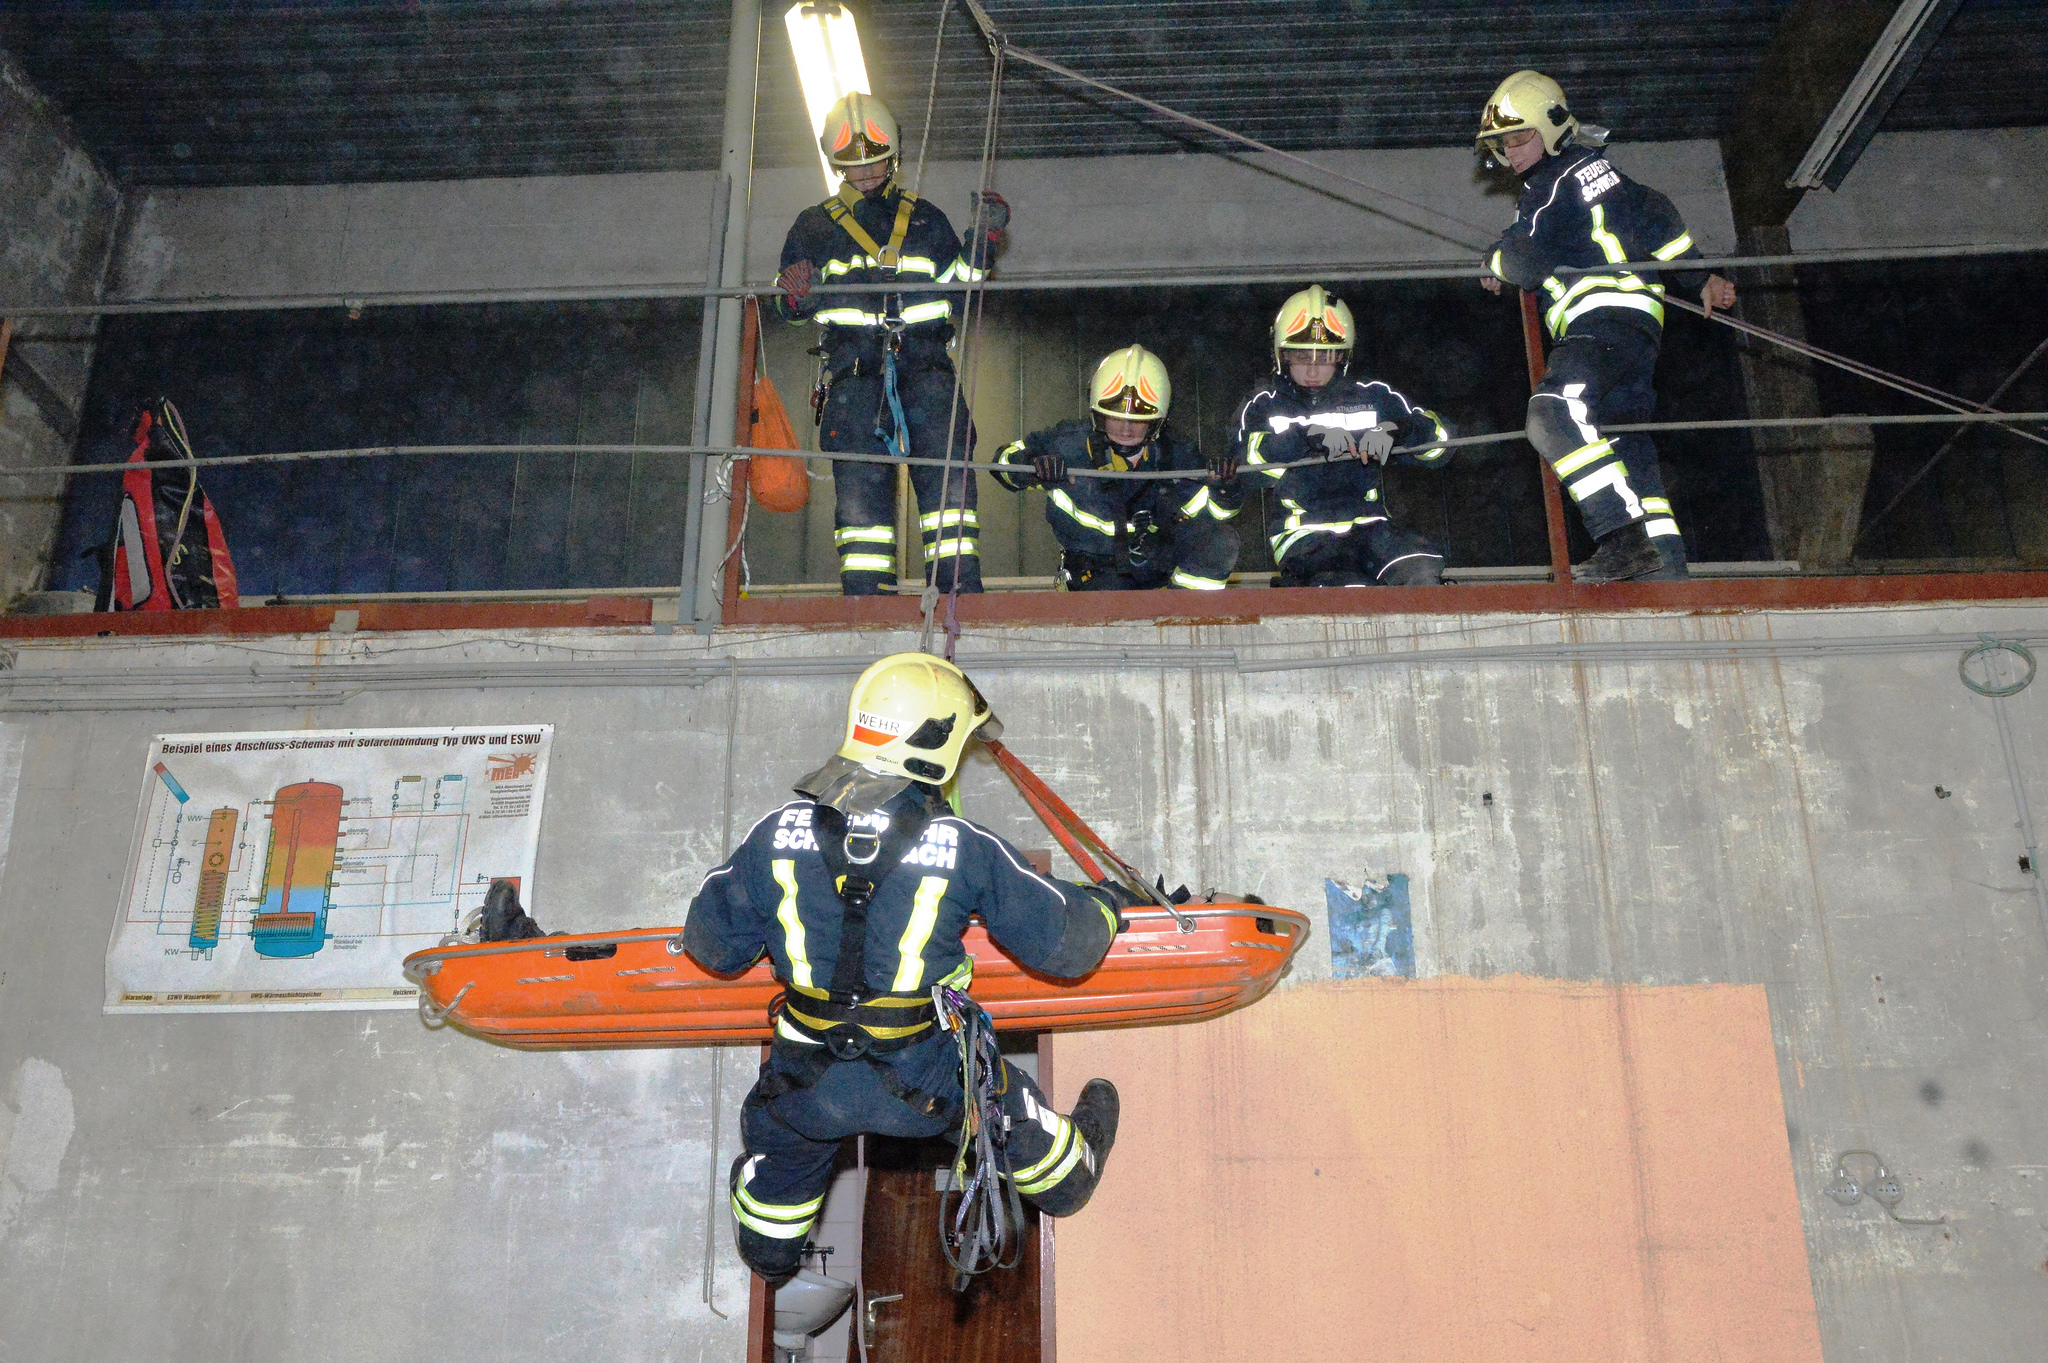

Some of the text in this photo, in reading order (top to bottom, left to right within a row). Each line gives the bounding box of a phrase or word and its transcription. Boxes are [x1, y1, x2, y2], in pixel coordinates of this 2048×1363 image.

[858, 711, 900, 733] WEHR
[162, 734, 542, 755] Beispiel eines Anschluss-Schemas mit Solareinbindung Typ UWS und ESWU
